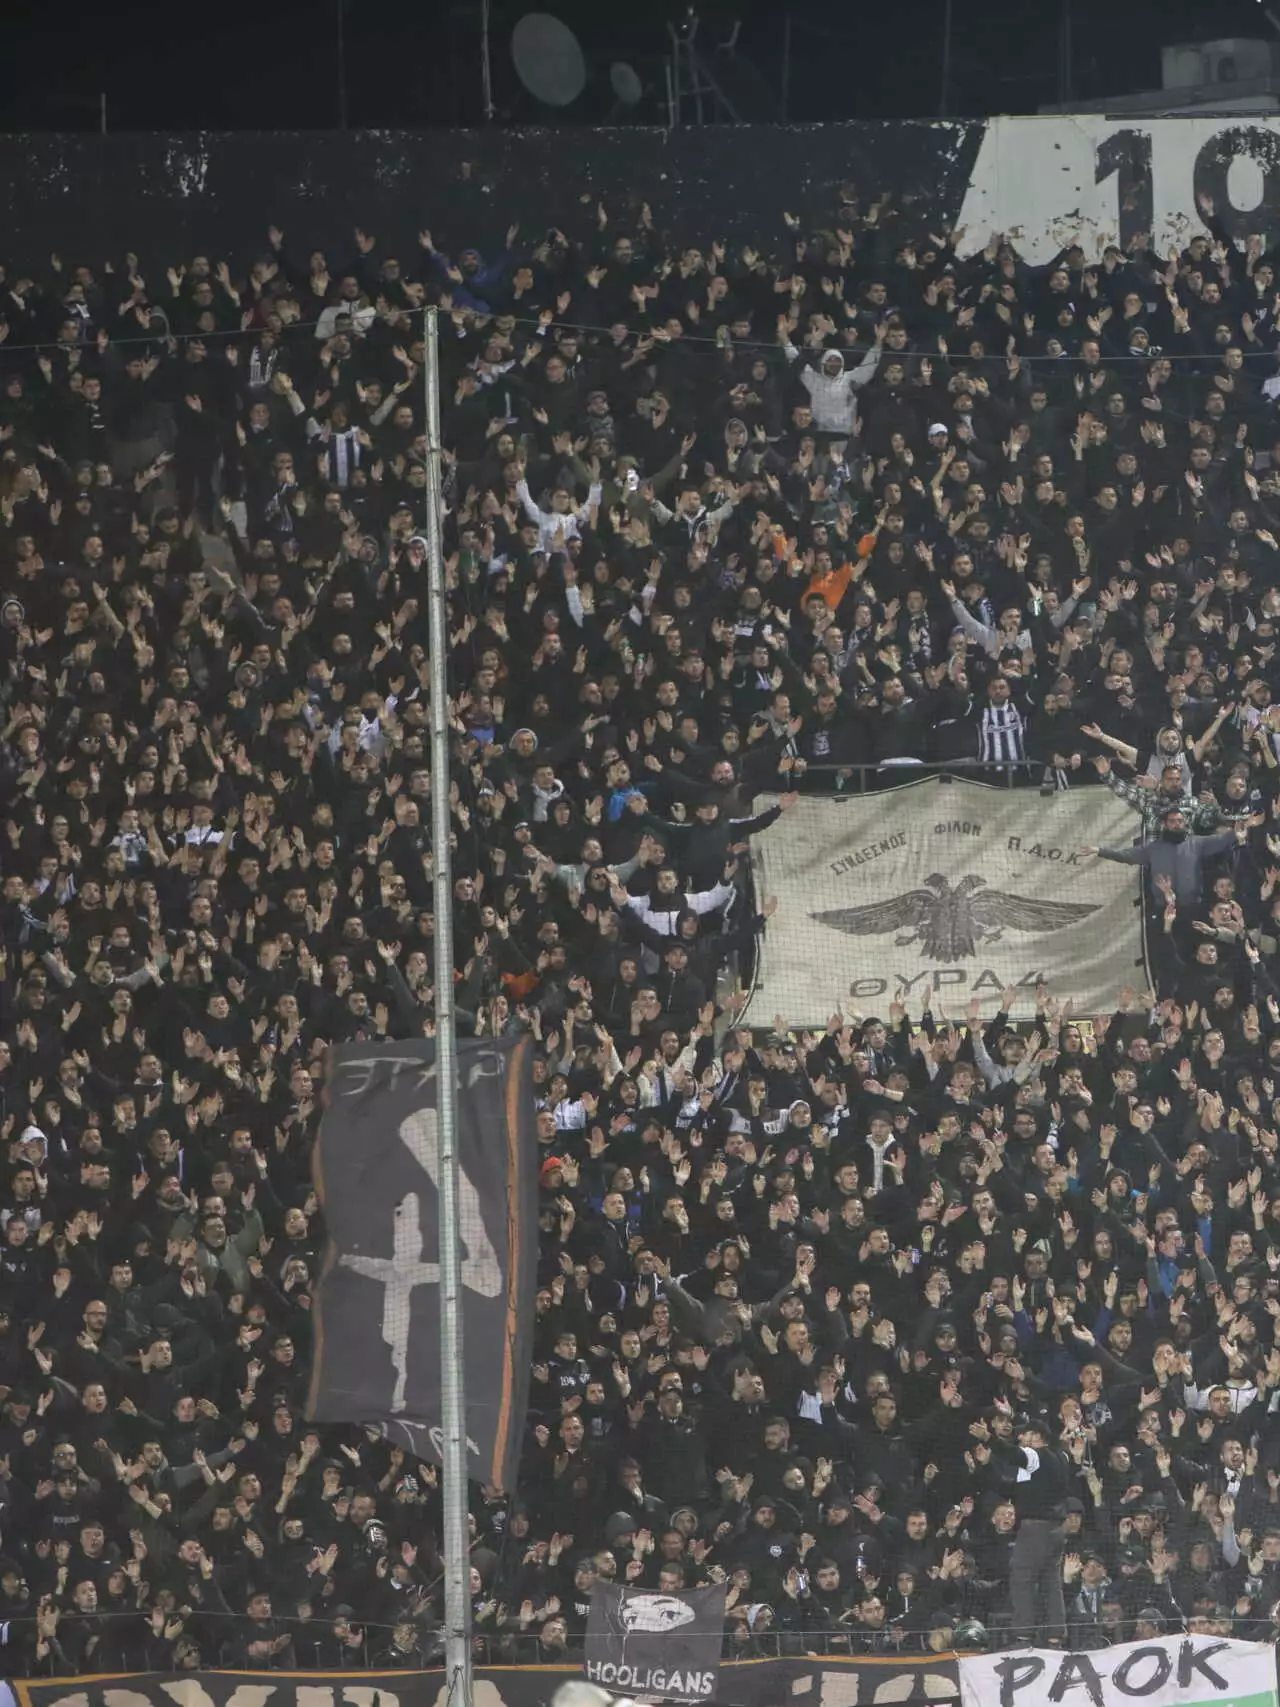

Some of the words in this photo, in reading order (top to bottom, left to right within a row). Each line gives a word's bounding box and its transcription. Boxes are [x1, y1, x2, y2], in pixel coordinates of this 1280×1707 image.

[850, 968, 1006, 998] ΘΥΡΑ
[1016, 970, 1049, 990] 4
[586, 1659, 717, 1695] HOOLIGANS
[993, 1638, 1232, 1707] PAOK
